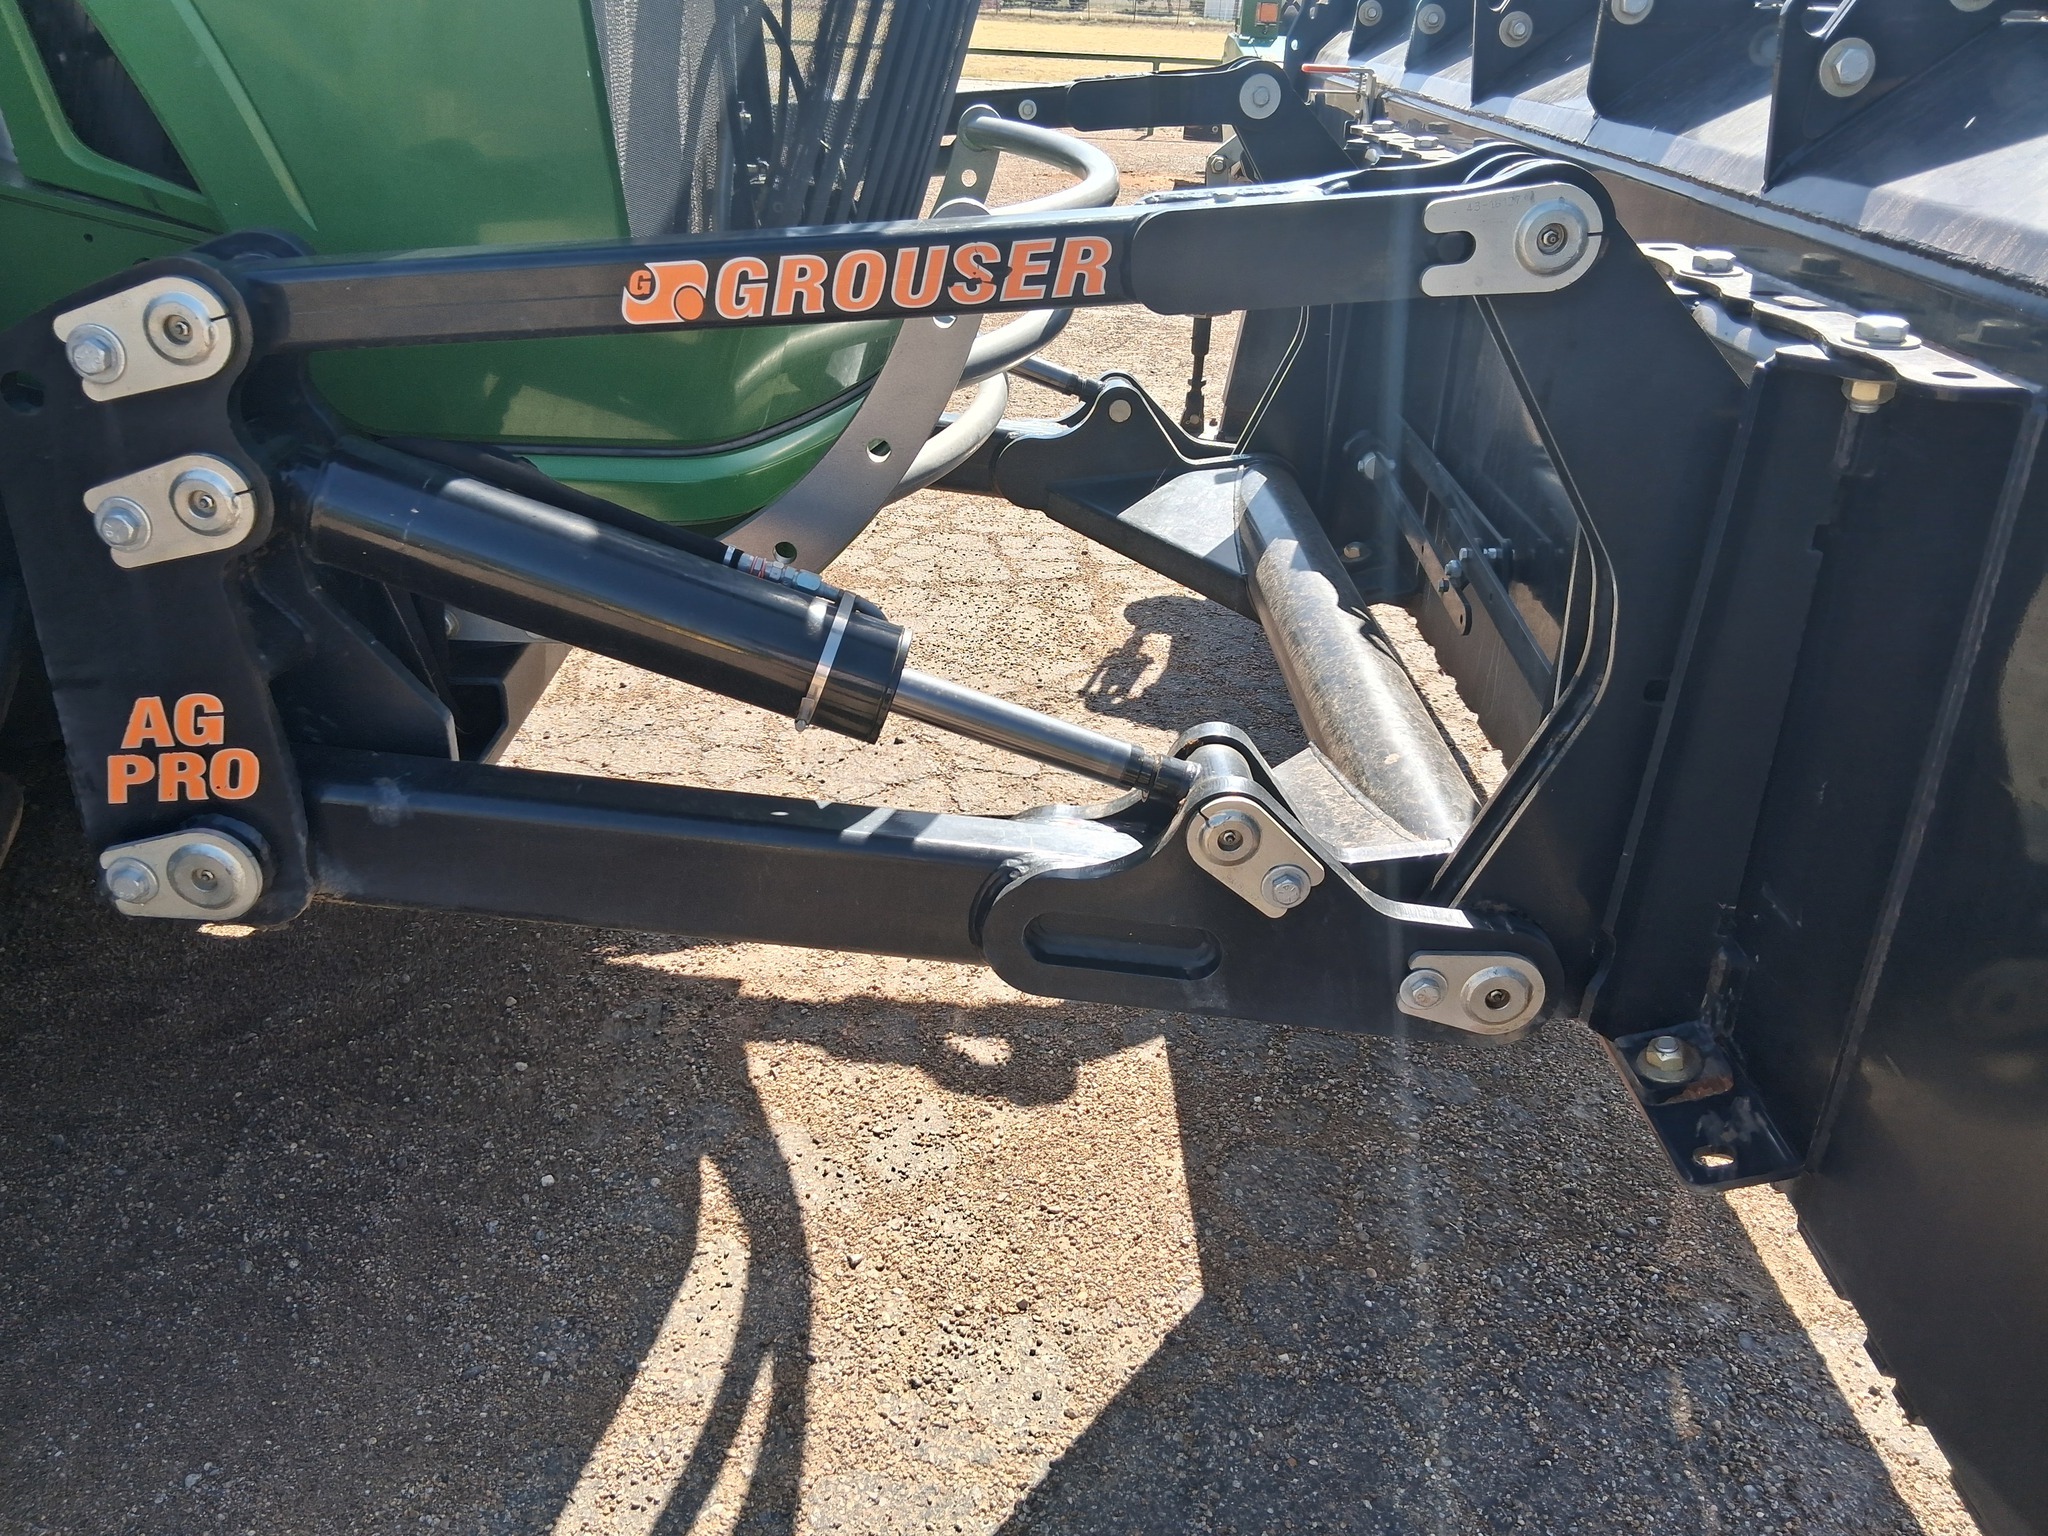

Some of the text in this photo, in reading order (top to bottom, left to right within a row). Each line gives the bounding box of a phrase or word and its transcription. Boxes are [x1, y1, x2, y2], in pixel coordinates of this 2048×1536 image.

[629, 269, 652, 296] G
[714, 236, 1112, 319] GROUSER
[120, 692, 225, 749] AG
[107, 747, 260, 804] PRO
